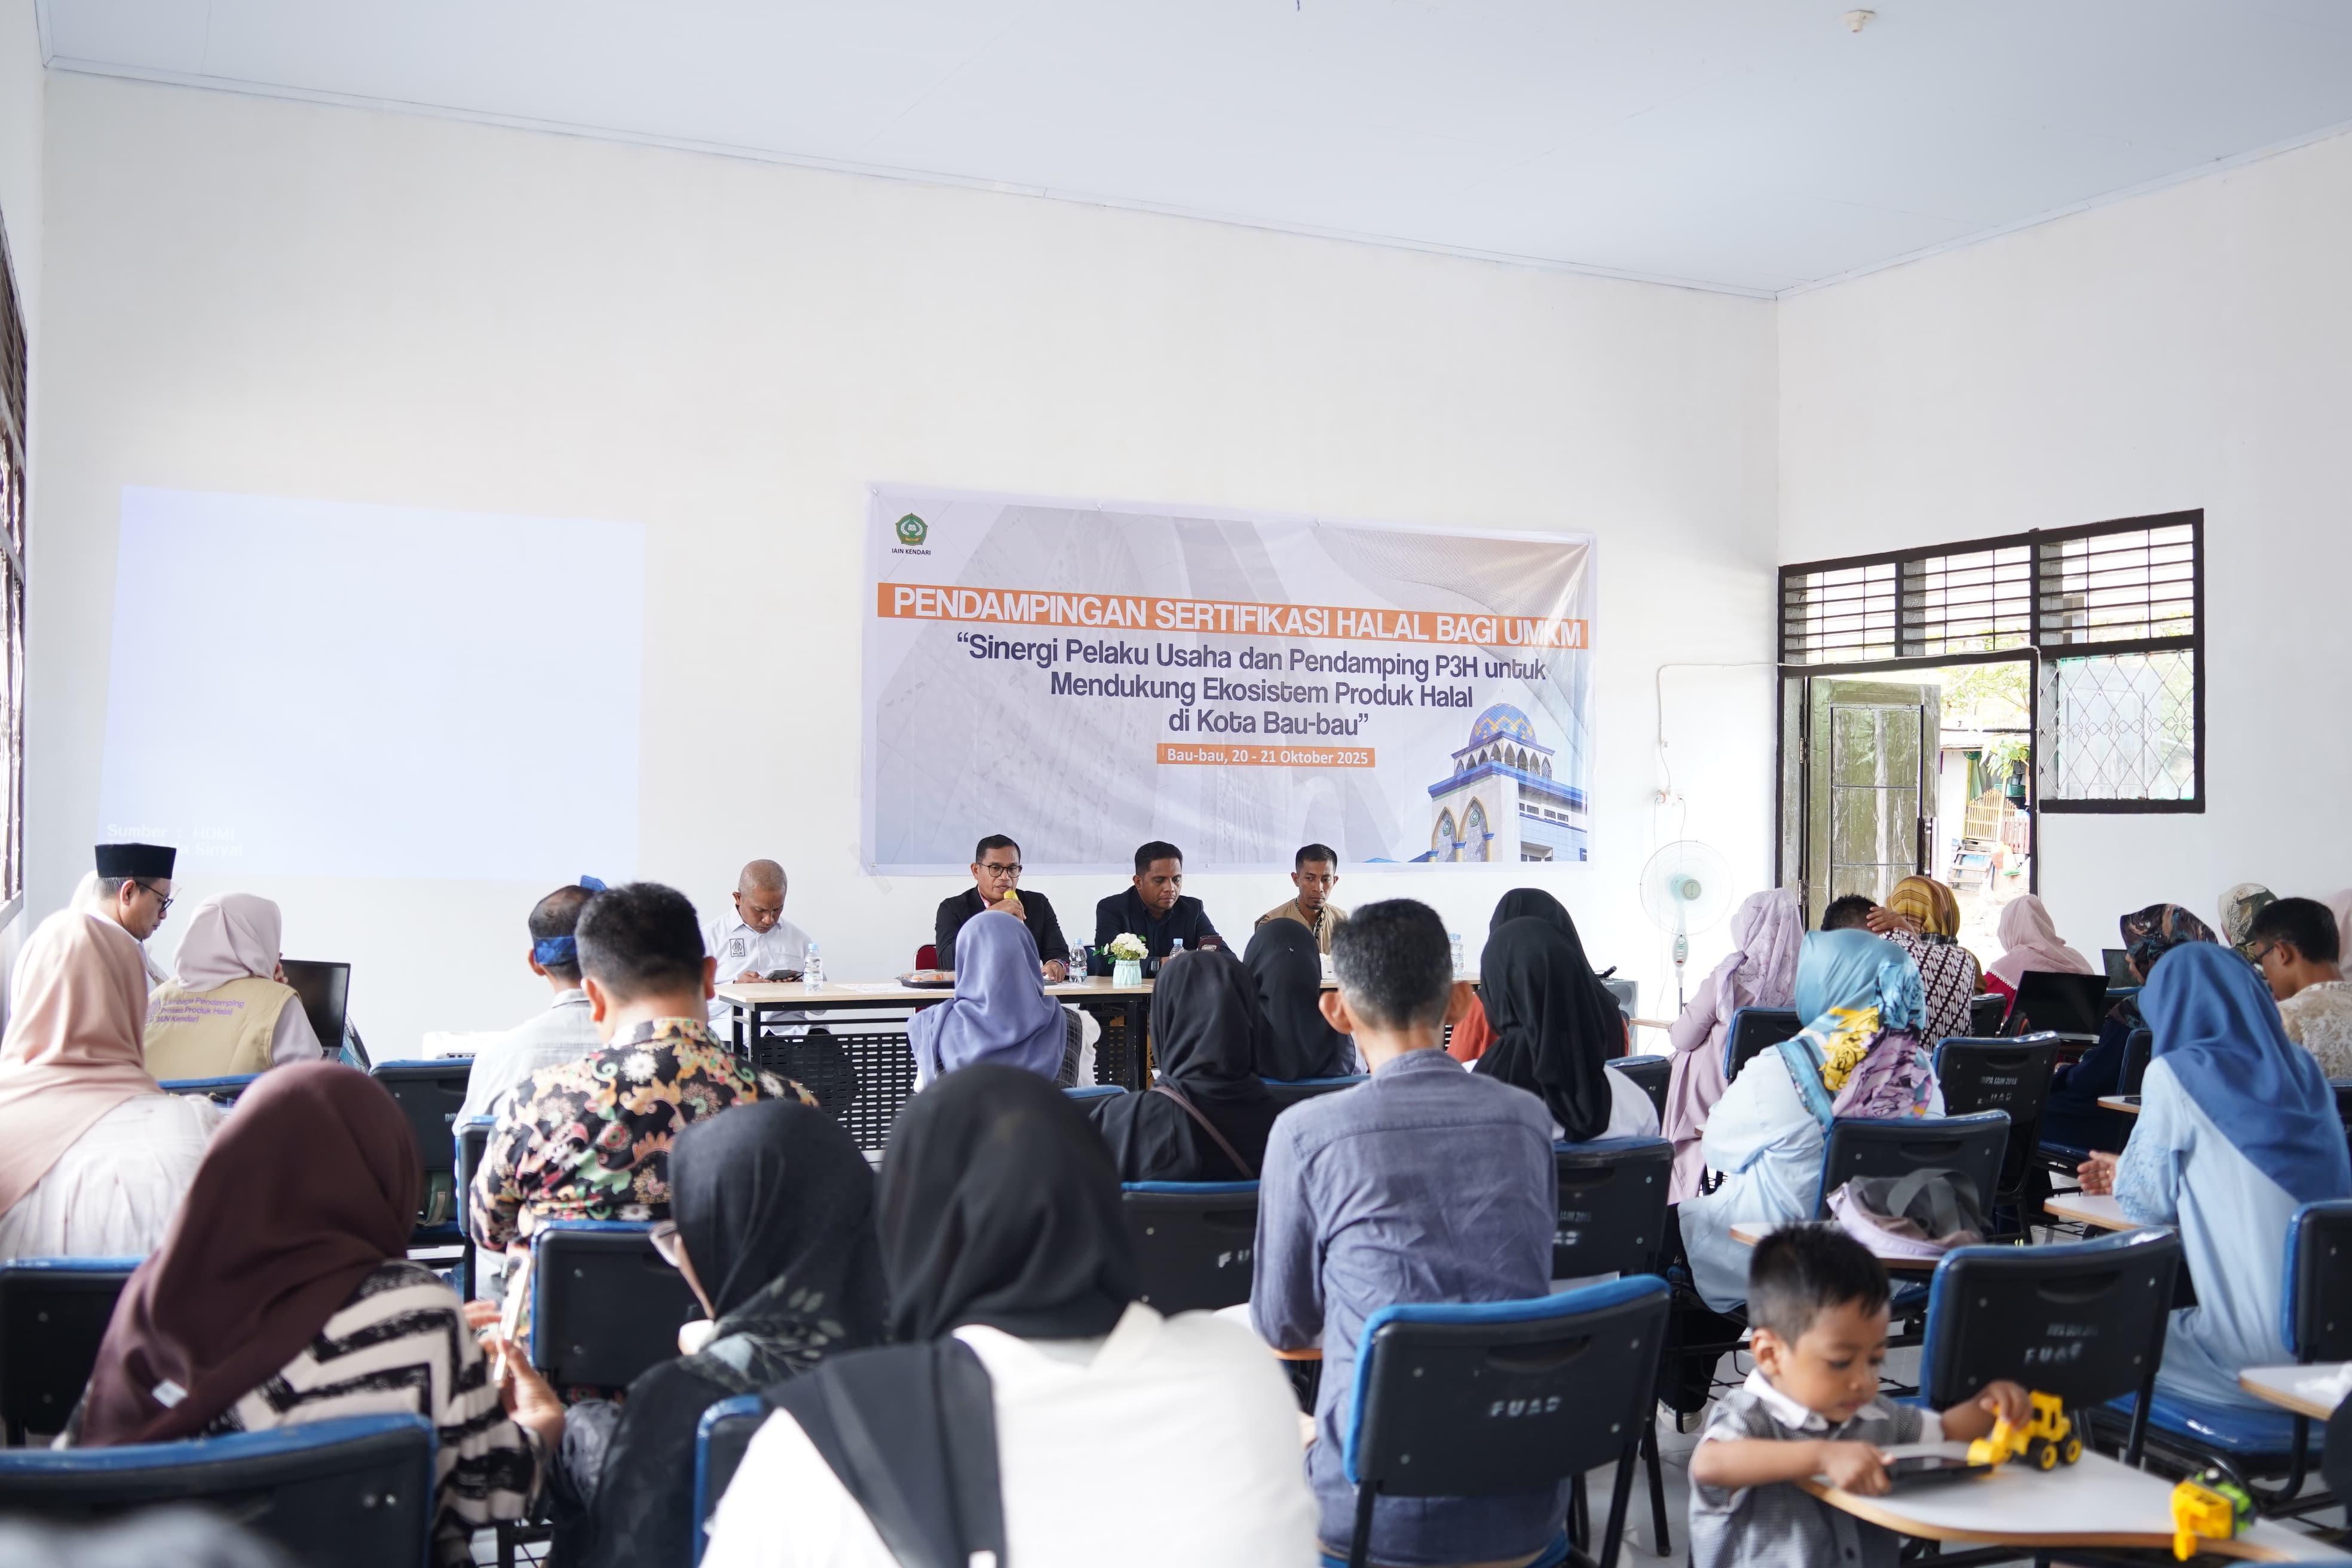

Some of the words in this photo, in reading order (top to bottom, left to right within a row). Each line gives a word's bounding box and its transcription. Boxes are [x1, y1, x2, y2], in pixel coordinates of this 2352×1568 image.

[895, 587, 1146, 627] PENDAMPINGAN
[1156, 601, 1328, 635] SERTIFIKASI
[1338, 612, 1429, 641] HALAL
[1437, 616, 1496, 644] BAGI
[1505, 620, 1581, 647] UMKM
[957, 632, 1057, 668] “Sinergi
[1066, 639, 1148, 666] Pelaku
[1157, 642, 1232, 668] Usaha
[1239, 647, 1282, 670] dan
[1290, 649, 1429, 682] Pendamping
[1436, 655, 1478, 678] P3H
[1485, 659, 1546, 681] untuk
[1051, 672, 1195, 706] Mendukung
[1203, 677, 1328, 703] Ekosistem
[1336, 682, 1414, 706] Produk
[1420, 685, 1473, 708] Halal
[1169, 709, 1189, 731] di
[1198, 709, 1256, 733] Kota
[1264, 711, 1369, 736] Bau-bau”
[1167, 748, 1229, 764] Bau-bau,
[1232, 749, 1248, 762] 20
[1261, 750, 1276, 763] 21
[1280, 750, 1334, 764] Oktober
[1337, 752, 1368, 765] 2025
[107, 823, 168, 838] Sumber
[195, 842, 243, 857] Sinyal
